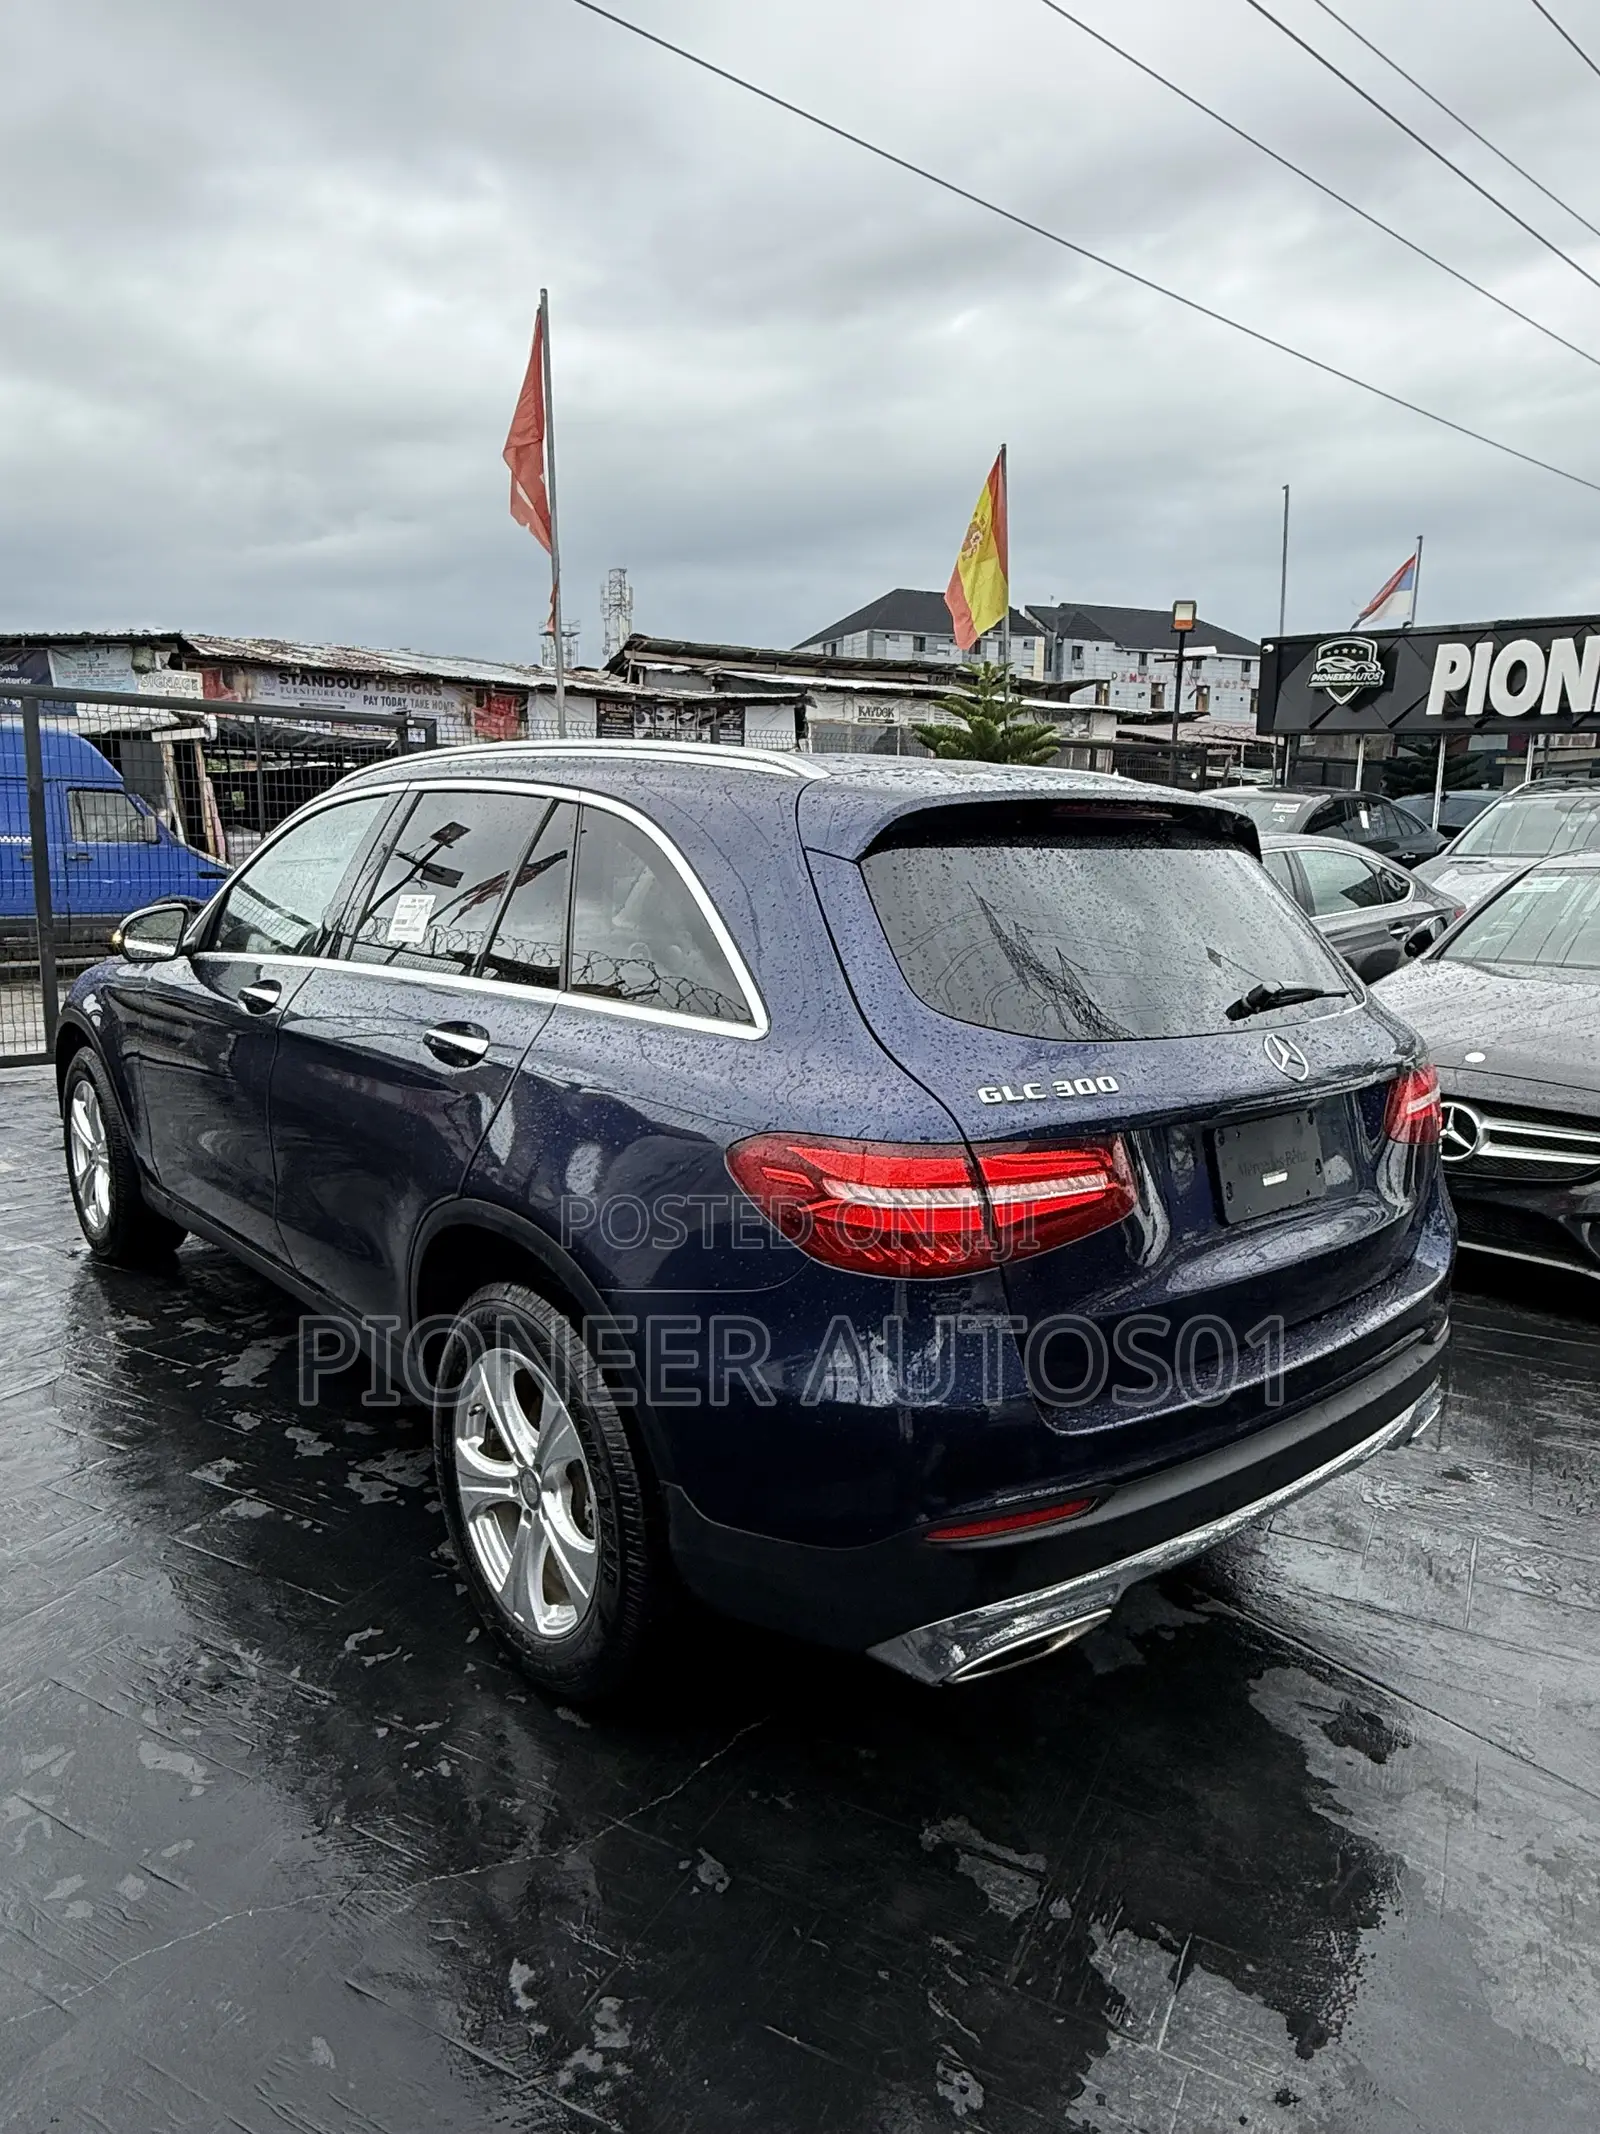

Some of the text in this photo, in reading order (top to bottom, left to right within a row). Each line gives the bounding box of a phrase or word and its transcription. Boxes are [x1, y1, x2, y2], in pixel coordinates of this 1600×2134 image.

[140, 674, 199, 691] SIGNAGE
[279, 672, 443, 697] STANDOUT DESIGNS
[1426, 635, 1600, 717] PION
[363, 694, 378, 706] PAY
[977, 1076, 1120, 1105] GLC 300
